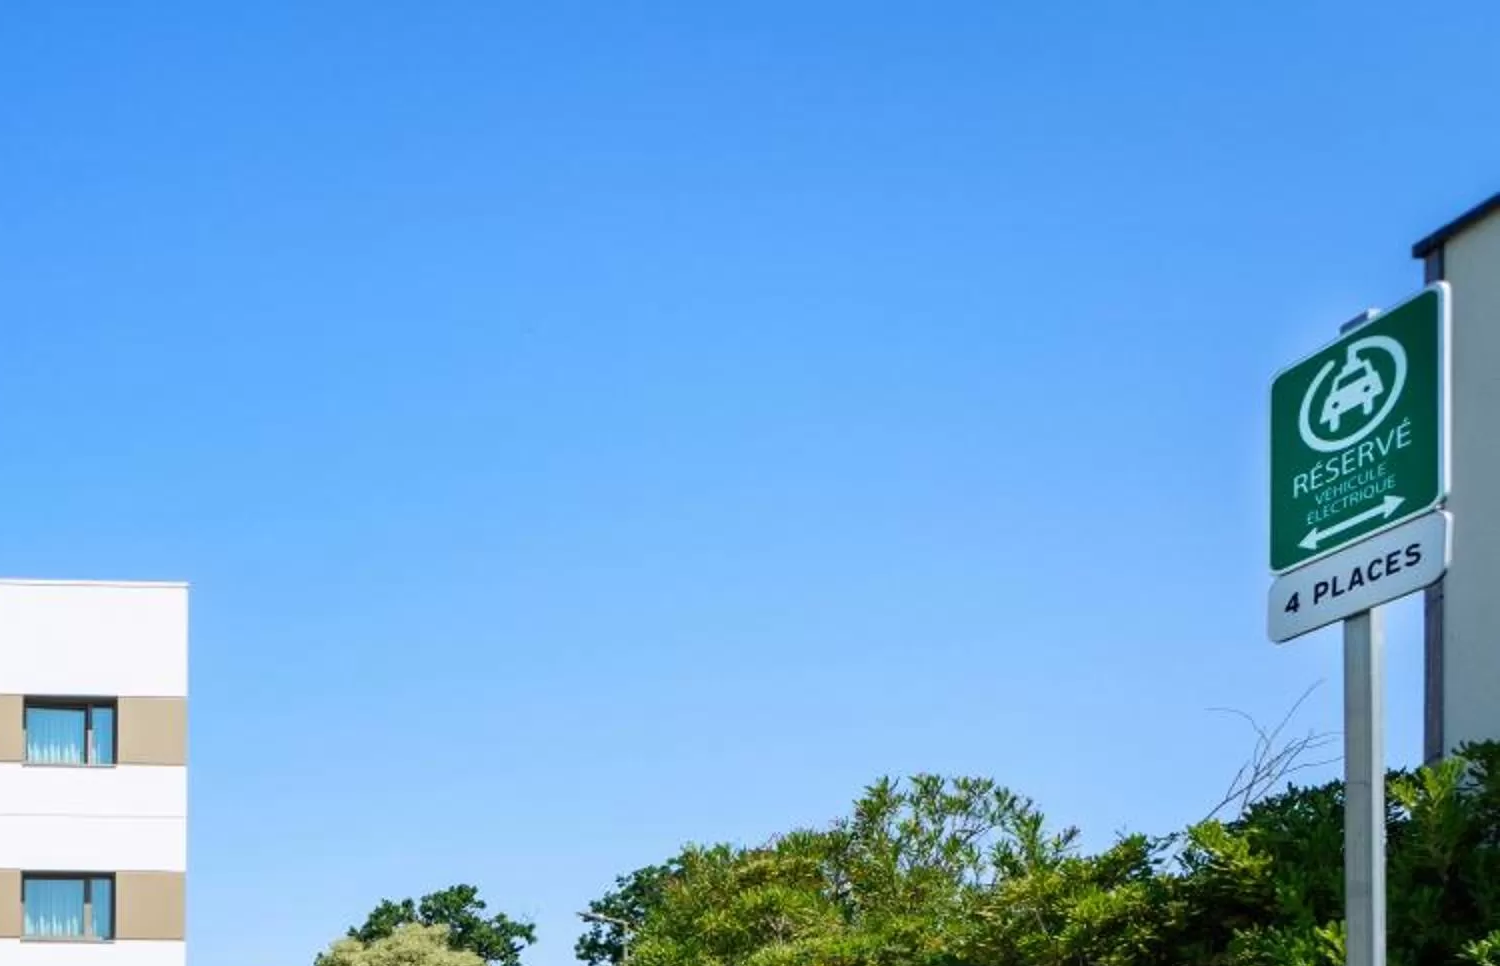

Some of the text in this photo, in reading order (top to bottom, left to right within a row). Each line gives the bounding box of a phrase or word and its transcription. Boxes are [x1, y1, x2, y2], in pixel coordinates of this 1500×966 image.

[1292, 416, 1412, 499] RÉSERVÉ
[1284, 543, 1422, 613] 4 PLACES
